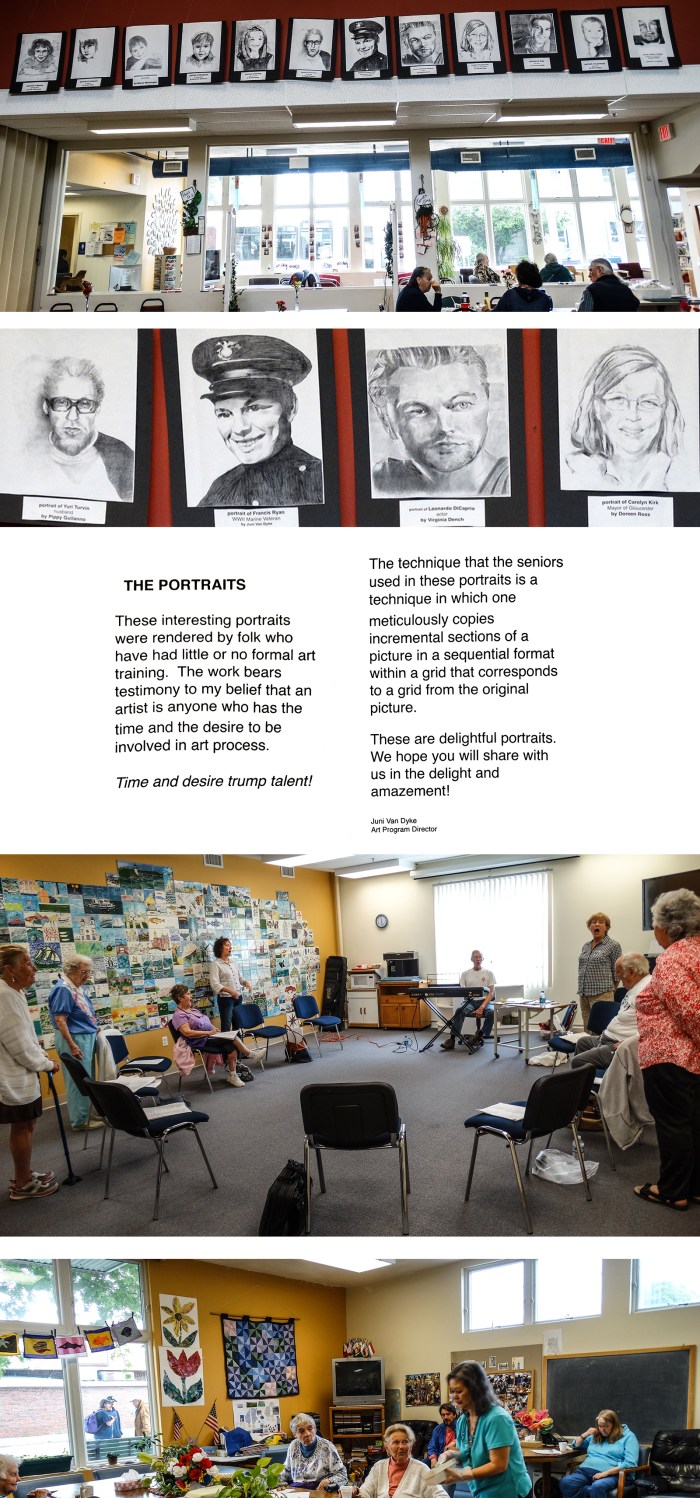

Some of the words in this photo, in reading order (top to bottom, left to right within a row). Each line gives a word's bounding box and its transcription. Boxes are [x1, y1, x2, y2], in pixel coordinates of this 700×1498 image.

[369, 558, 394, 570] The
[398, 556, 461, 571] technique
[464, 556, 489, 568] that
[492, 555, 513, 568] the
[517, 555, 564, 568] seniors
[123, 579, 154, 591] THE
[159, 578, 246, 591] PORTRAITS
[369, 575, 400, 588] used
[405, 575, 416, 587] in
[419, 574, 455, 587] these
[459, 573, 512, 589] portraits
[516, 573, 526, 585] is
[530, 576, 538, 585] a
[115, 615, 157, 627] These
[162, 614, 231, 629] interesting
[236, 614, 291, 628] portraits
[115, 634, 148, 644] were
[152, 631, 213, 643] rendered
[217, 631, 233, 646] by
[237, 631, 261, 643] folk
[265, 631, 293, 643] who
[115, 667, 168, 681] training.
[177, 666, 204, 677] The
[207, 665, 240, 677] work
[244, 666, 282, 678] bears
[370, 733, 410, 745] These
[414, 735, 435, 745] are
[439, 732, 497, 747] delightful
[501, 732, 556, 746] portraits.
[116, 776, 149, 789] Time
[152, 775, 179, 788] and
[182, 775, 224, 787] desire
[228, 775, 267, 789] trump
[271, 775, 313, 787] talent!
[400, 817, 417, 825] Dyke
[382, 826, 410, 834] Program
